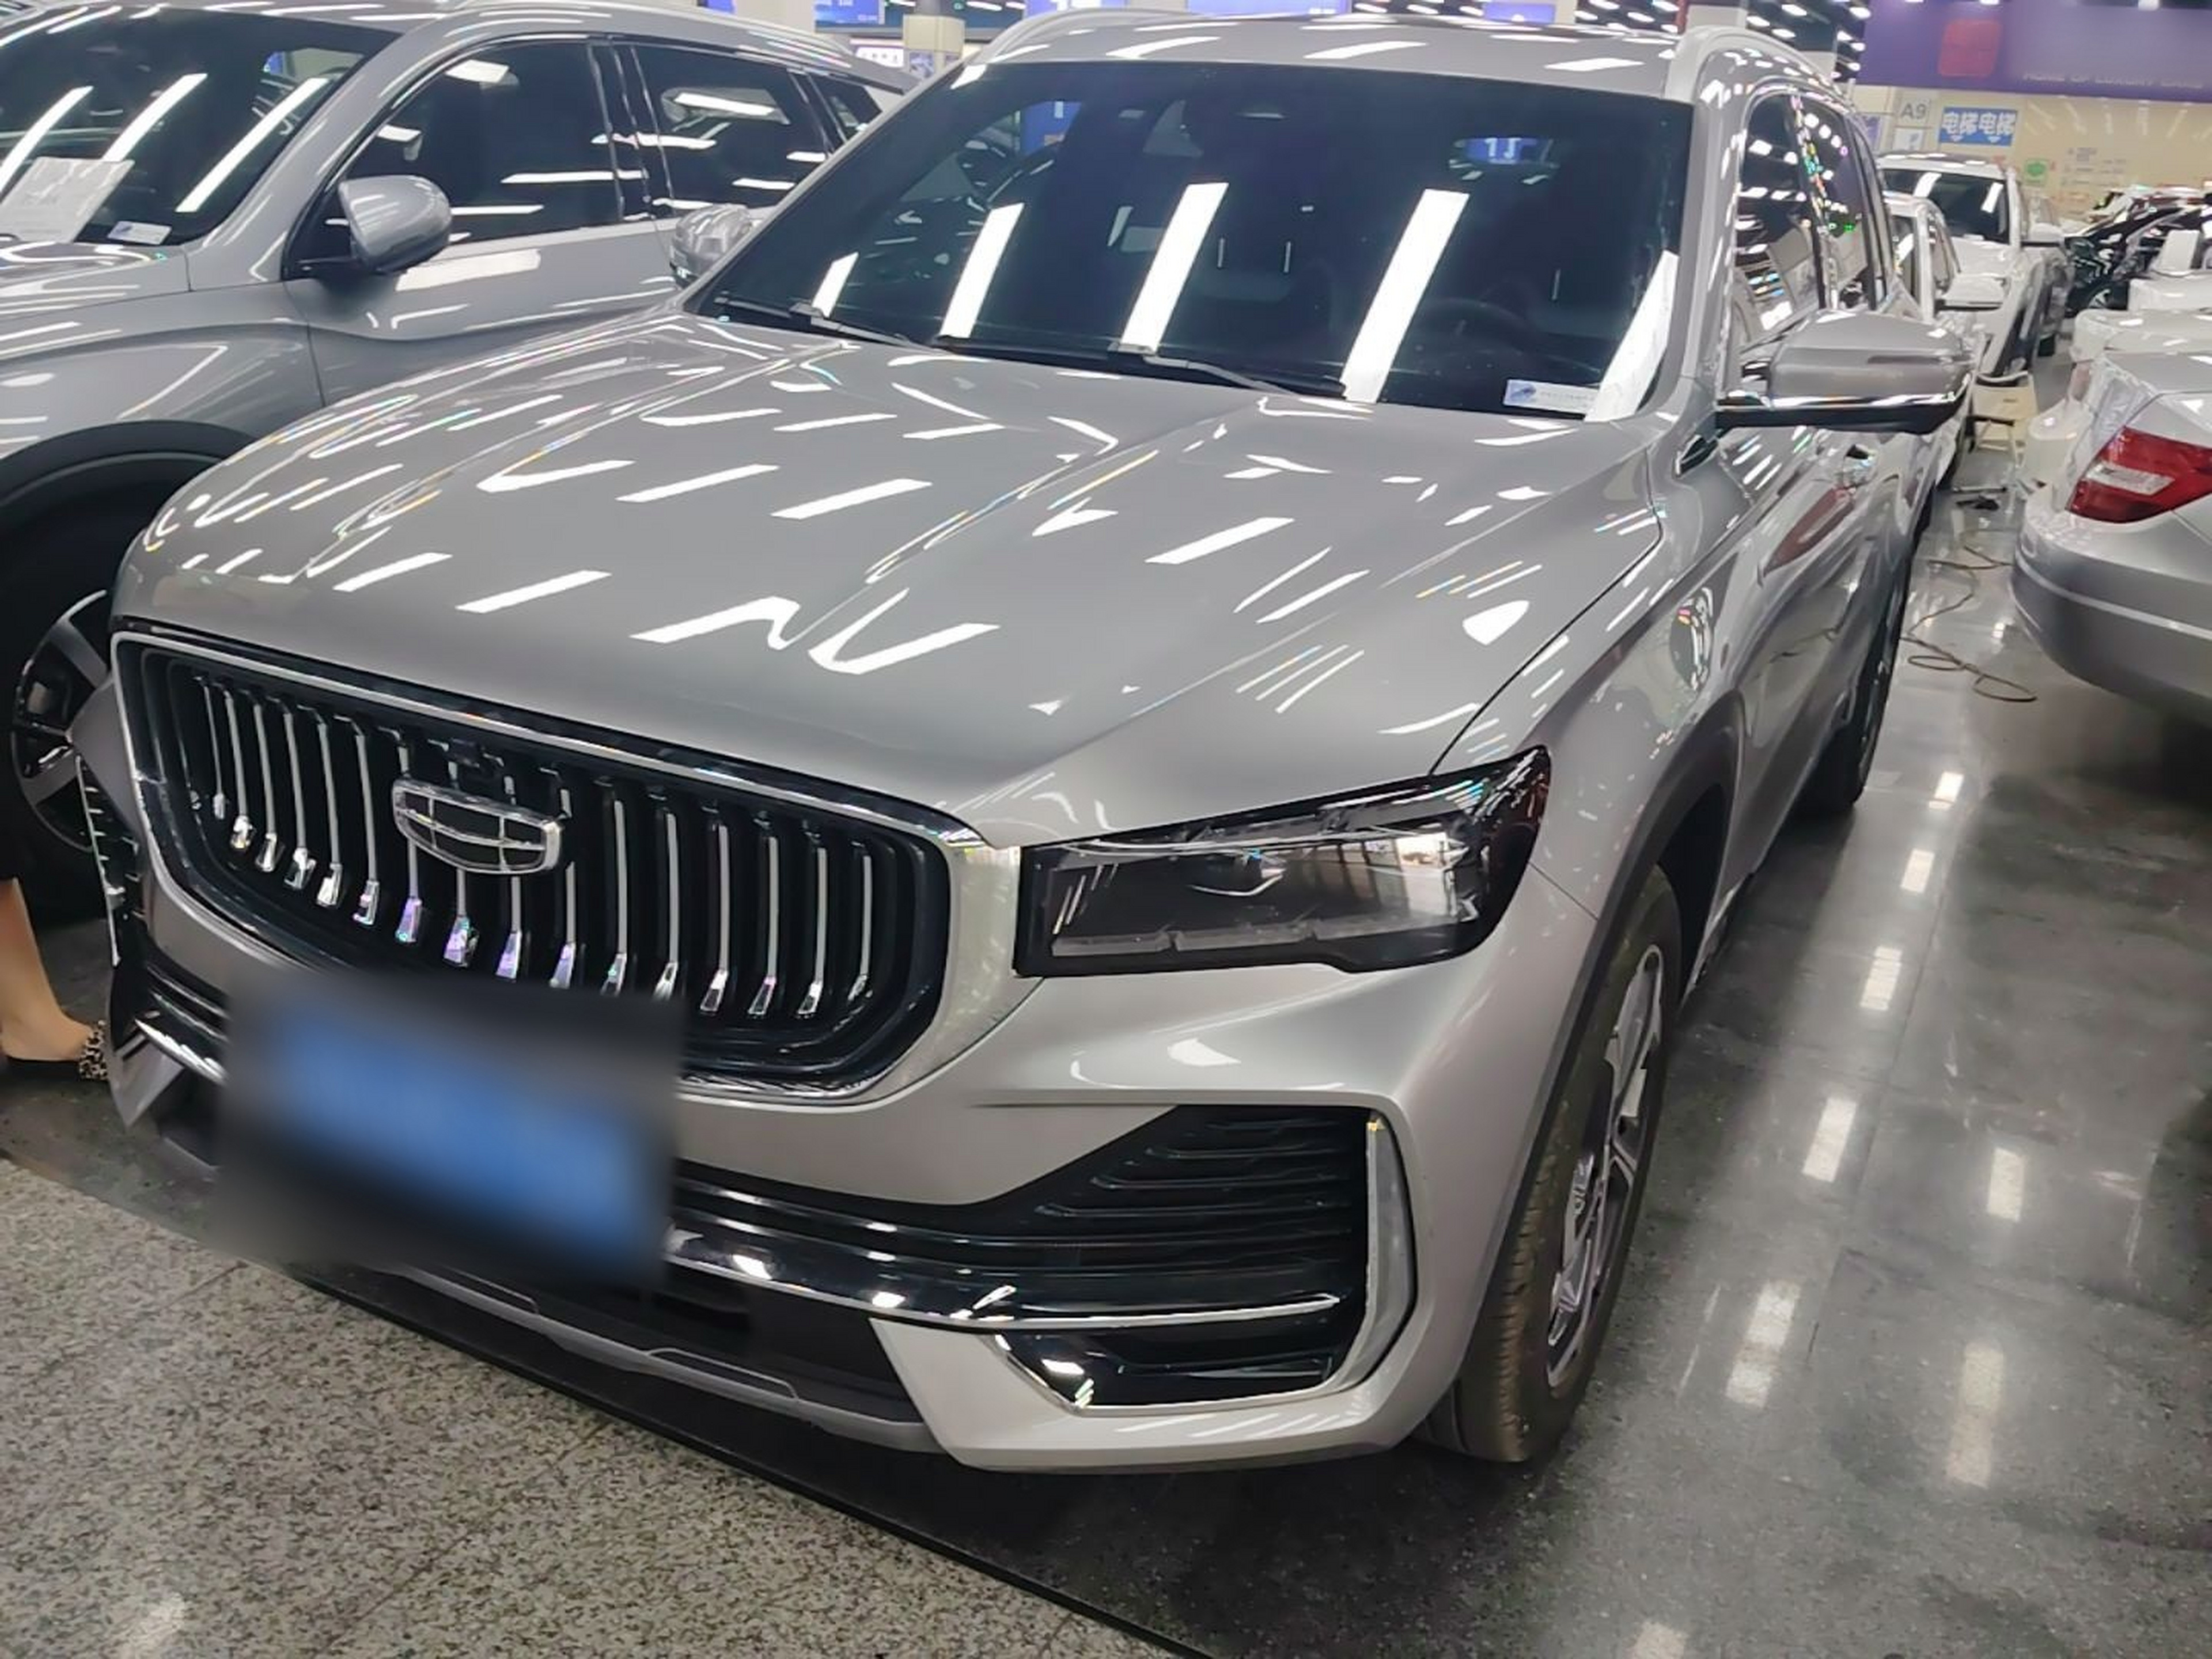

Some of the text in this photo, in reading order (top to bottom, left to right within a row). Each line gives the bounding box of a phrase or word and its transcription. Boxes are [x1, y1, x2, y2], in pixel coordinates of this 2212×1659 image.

[1902, 103, 1927, 120] A9
[1942, 111, 2016, 135] 电梯电梯
